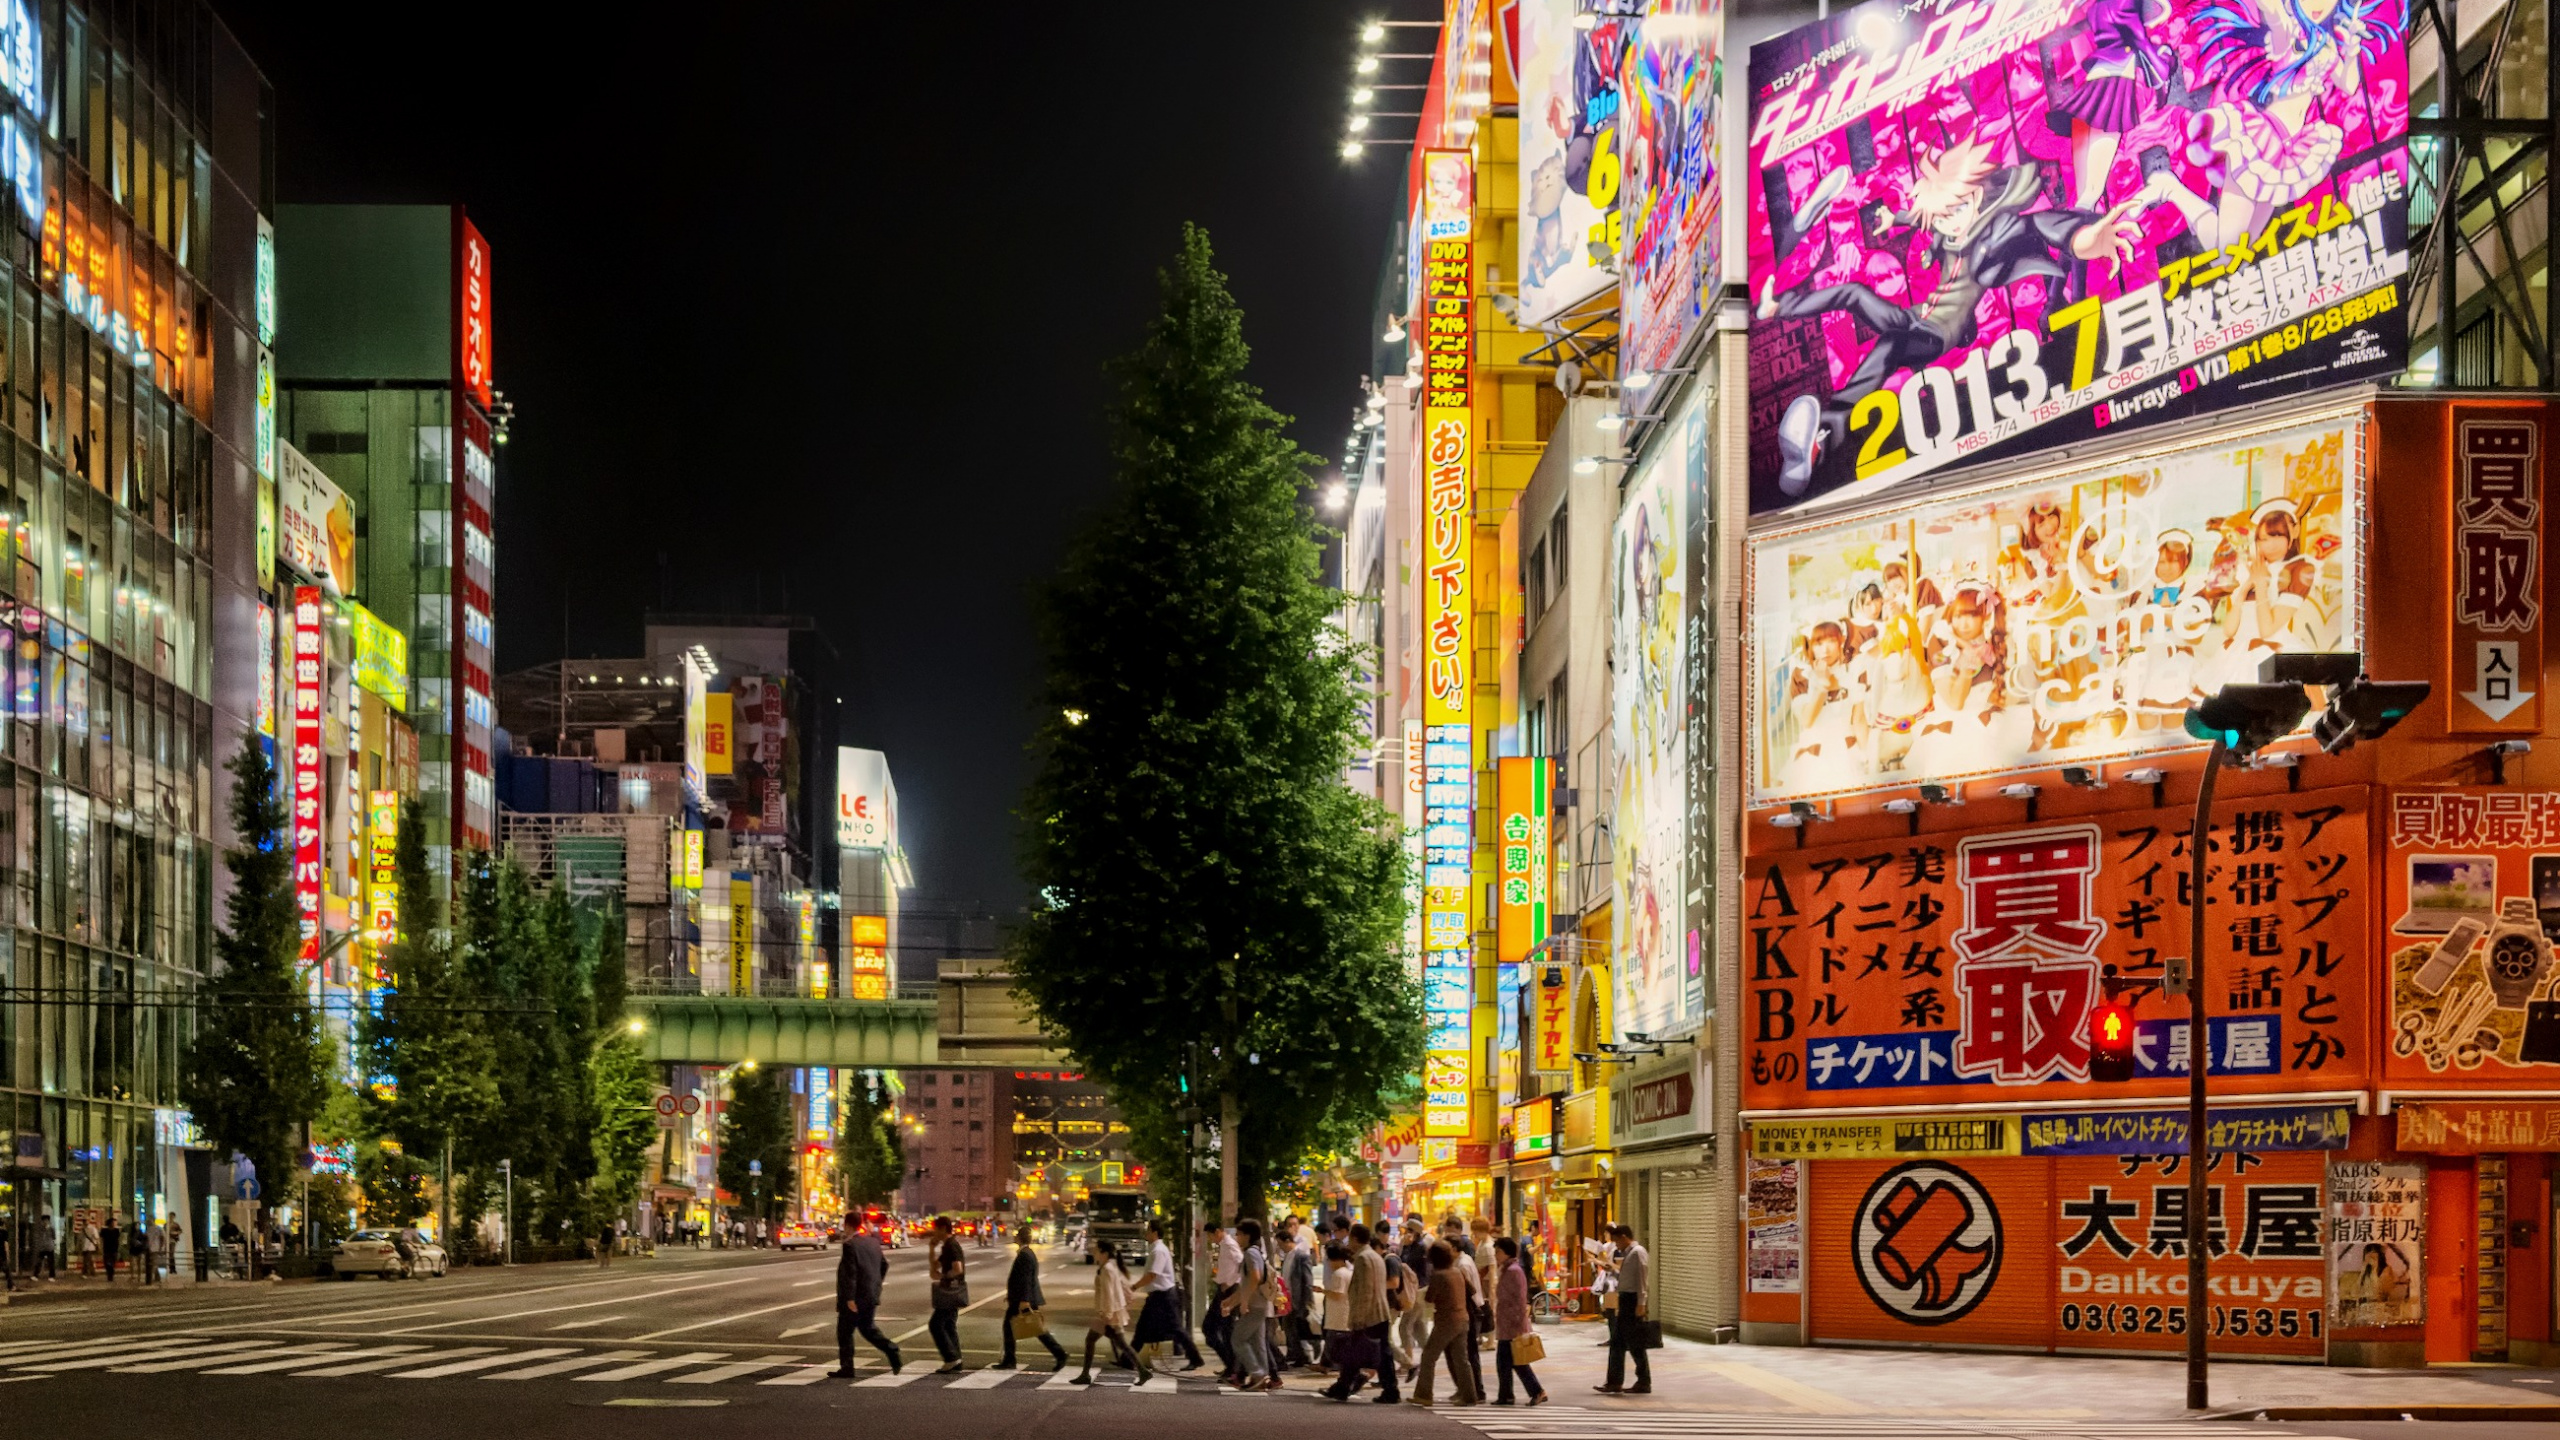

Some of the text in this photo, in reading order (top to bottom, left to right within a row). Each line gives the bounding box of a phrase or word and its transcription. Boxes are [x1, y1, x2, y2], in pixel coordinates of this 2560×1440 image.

[1761, 36, 1862, 98] コロシアイ学園生
[1886, 3, 2075, 118] THE ANIMATION
[1430, 219, 1468, 237] あなたの
[1430, 242, 1467, 261] DVD
[1429, 262, 1468, 278] ブルーレイ
[1429, 279, 1468, 296] ゲーム
[65, 273, 150, 368] ホルモン
[469, 237, 483, 387] カラオケ
[1429, 316, 1467, 333] アイドル
[1435, 298, 1462, 316] CD
[1428, 335, 1468, 352] アニメ
[2332, 351, 2388, 369] UNIVERSAL
[1430, 354, 1466, 370] コミック
[2107, 349, 2180, 392] CBC:7/5
[1431, 372, 1465, 389] ホビー
[1429, 390, 1468, 408] フィギュア
[2030, 387, 2095, 424] TBS:7/5
[1956, 420, 2018, 456] MBS:7/4
[291, 456, 328, 498] ハニトー
[2458, 420, 2540, 632] 買取
[284, 529, 327, 574] カラオケ
[2484, 648, 2512, 701] 入口
[297, 602, 319, 942] 曲数世界一カラオケパセラ
[1429, 745, 1468, 765] DVD
[1429, 786, 1467, 805] DVD
[1426, 807, 1444, 823] 4F
[1429, 825, 1467, 845] DVD
[1427, 848, 1444, 863] 3F
[1504, 814, 1530, 904] 吉野家
[1534, 815, 1545, 903] YOSHINOYA
[1430, 912, 1465, 928] 買取
[1854, 852, 1896, 981] アニメ
[2228, 809, 2284, 1010] 携帯電話
[1430, 931, 1466, 946] フロア
[1808, 857, 1849, 1027] アイドル
[1899, 845, 1946, 1028] 美少女系
[2291, 805, 2348, 1070] アップルとか
[1951, 826, 2107, 1086] 買取
[1543, 986, 1565, 1067] ゴーゴーカレー
[1810, 1037, 1947, 1084] チケット
[1428, 1093, 1466, 1105] AKIBA
[1611, 1076, 1631, 1139] ZIN
[1759, 1125, 1882, 1140] MONEY TRANSFER
[1896, 1121, 1986, 1138] WESTERN
[1924, 1136, 1986, 1151] UNION
[2332, 1164, 2380, 1178] AKB48
[2332, 1190, 2419, 1203] 選抜総選挙
[2057, 1185, 2324, 1260] 大黒屋
[2331, 1217, 2420, 1243] 指原莉乃
[2060, 1267, 2323, 1302] Daikokuya
[2061, 1303, 2322, 1338] 03(325)5351
